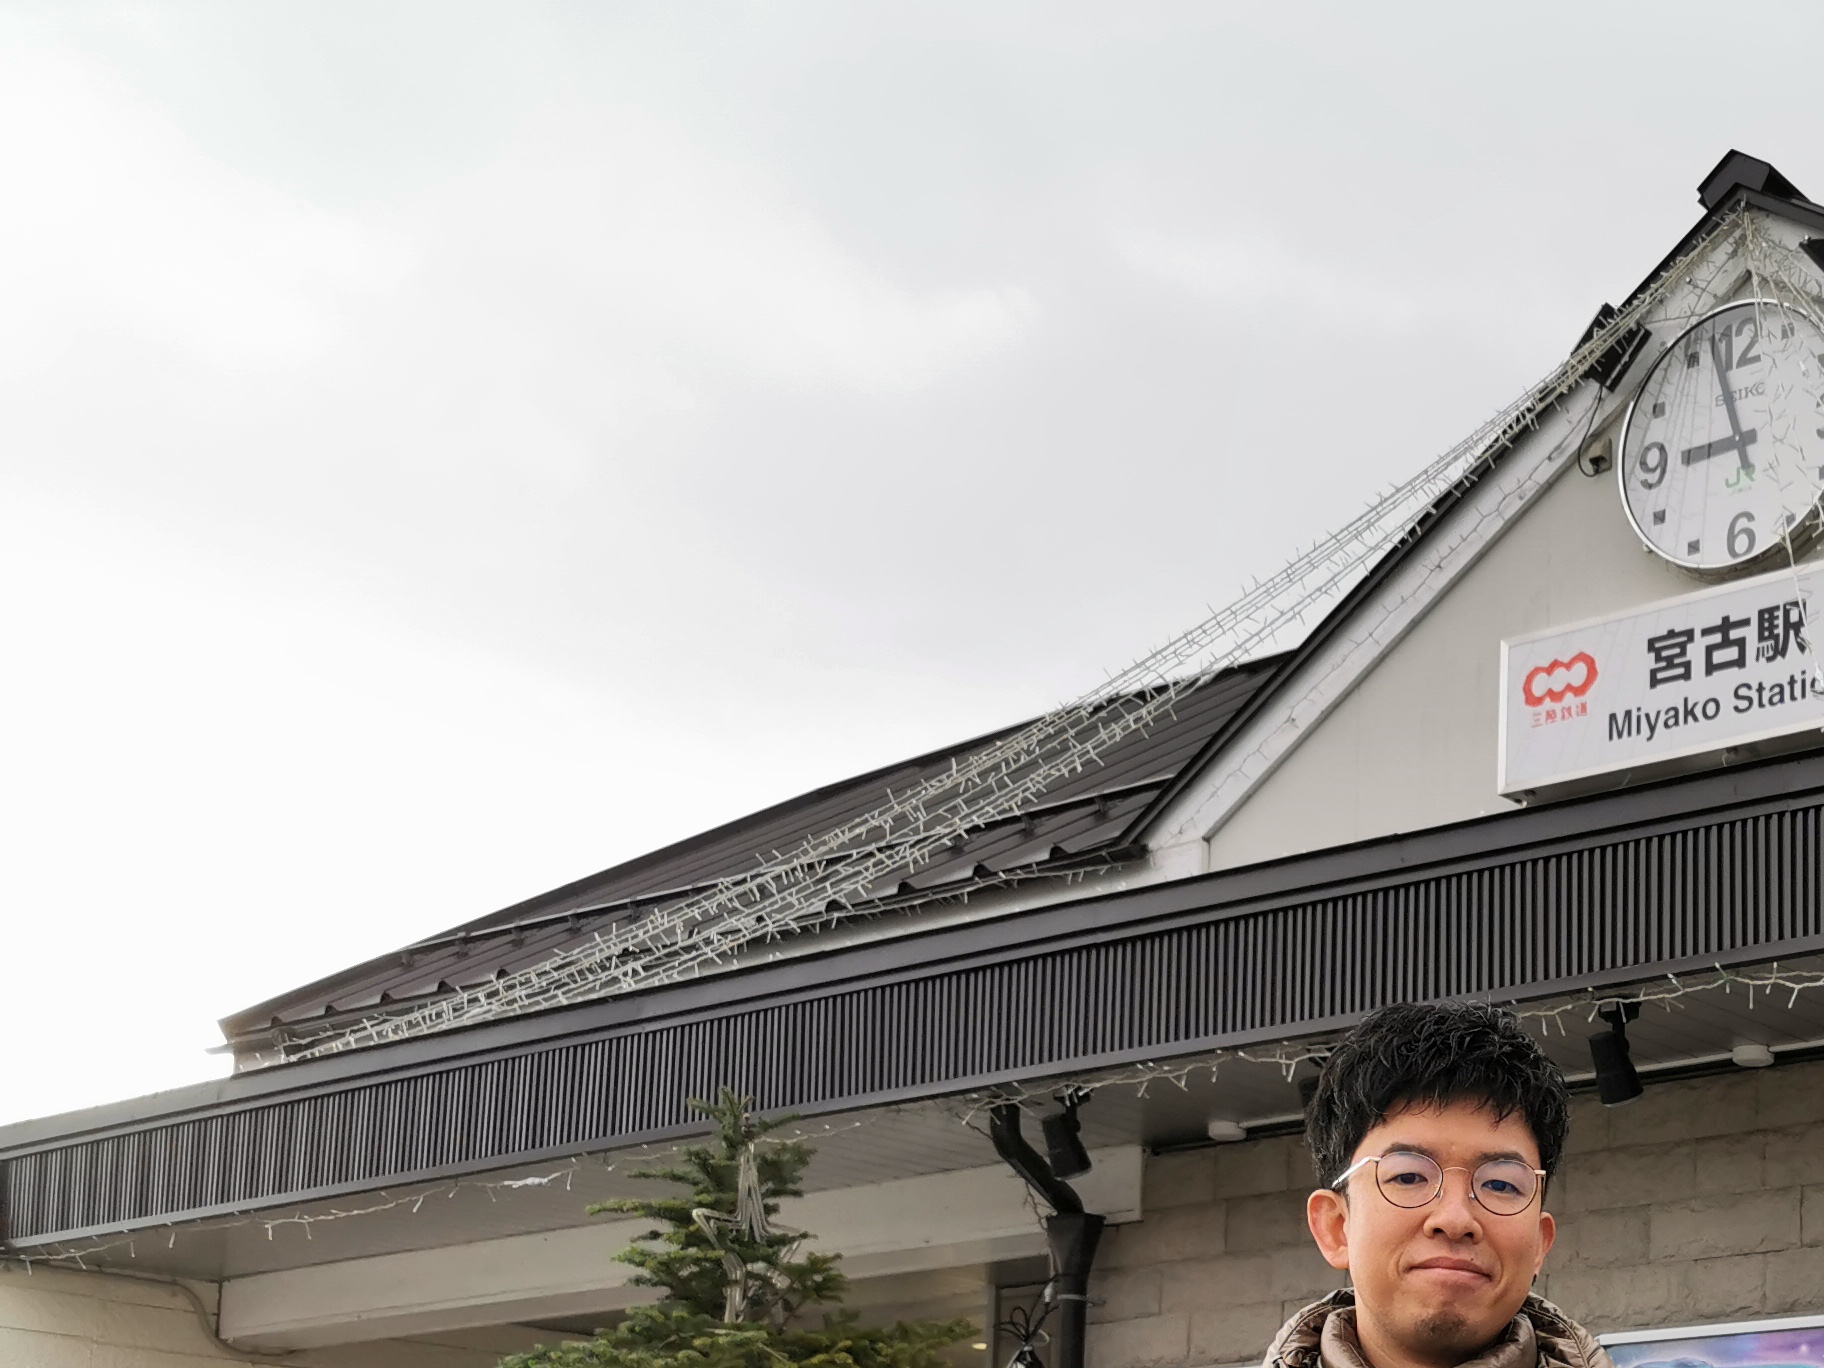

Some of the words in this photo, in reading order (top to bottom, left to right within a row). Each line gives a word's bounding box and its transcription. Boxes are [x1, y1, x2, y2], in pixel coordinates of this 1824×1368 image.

[1719, 317, 1762, 372] 12
[1638, 441, 1669, 490] 9
[1725, 511, 1757, 560] 6
[1647, 598, 1808, 690] 宮古駅
[1608, 696, 1722, 742] Miyako
